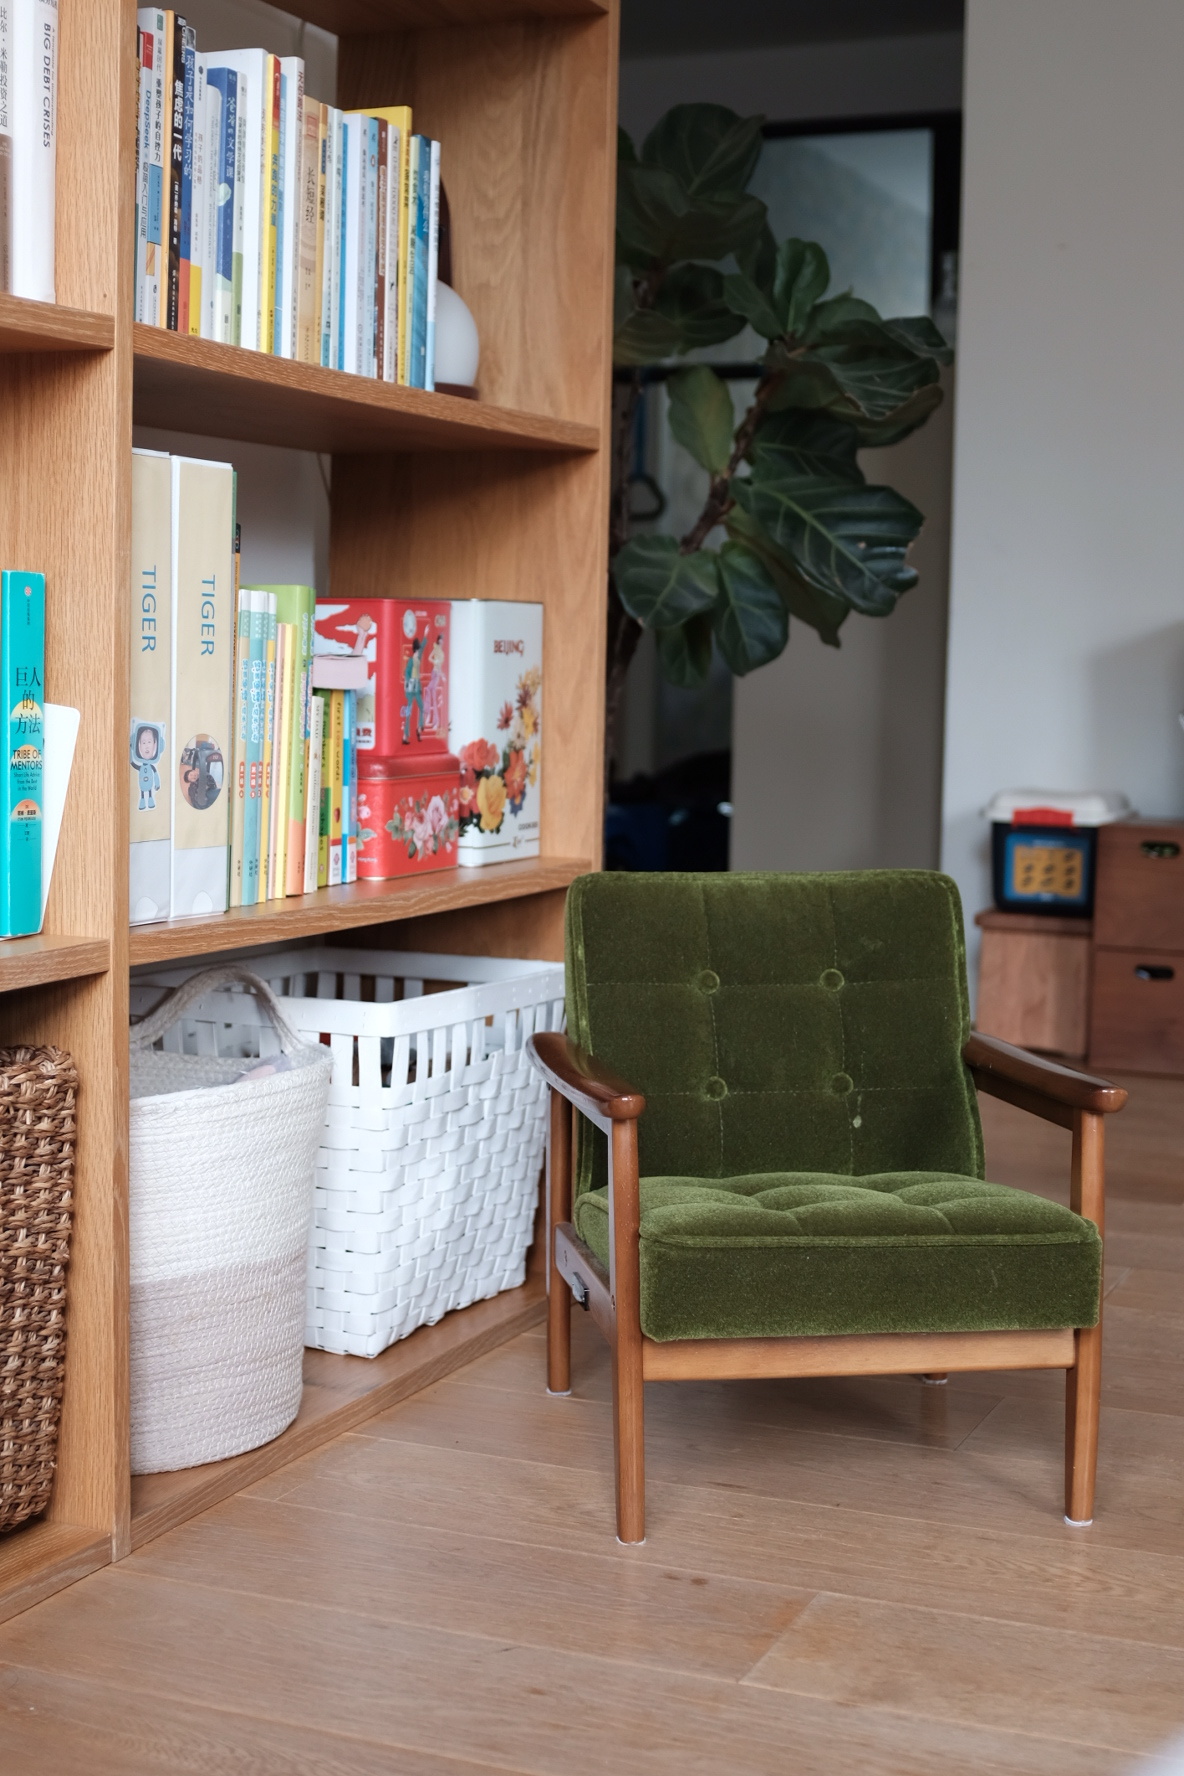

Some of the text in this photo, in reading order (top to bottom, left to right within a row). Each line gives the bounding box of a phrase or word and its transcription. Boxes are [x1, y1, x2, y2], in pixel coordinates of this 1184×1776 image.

[42, 22, 52, 148] BIG DEBT CRISES
[143, 90, 152, 149] DeepSeek
[173, 79, 184, 162] 焦虑的一代
[183, 54, 195, 180] 孩子是如何学习的
[305, 166, 316, 225] 长短经
[141, 564, 157, 652] TIGER
[200, 574, 216, 656] TIGER
[15, 666, 42, 688] 巨人
[493, 639, 525, 657] BEIJING
[15, 713, 41, 734] 方法
[22, 689, 35, 711] 的
[10, 760, 43, 771] MENTORS
[13, 749, 42, 760] TRIBE OF
